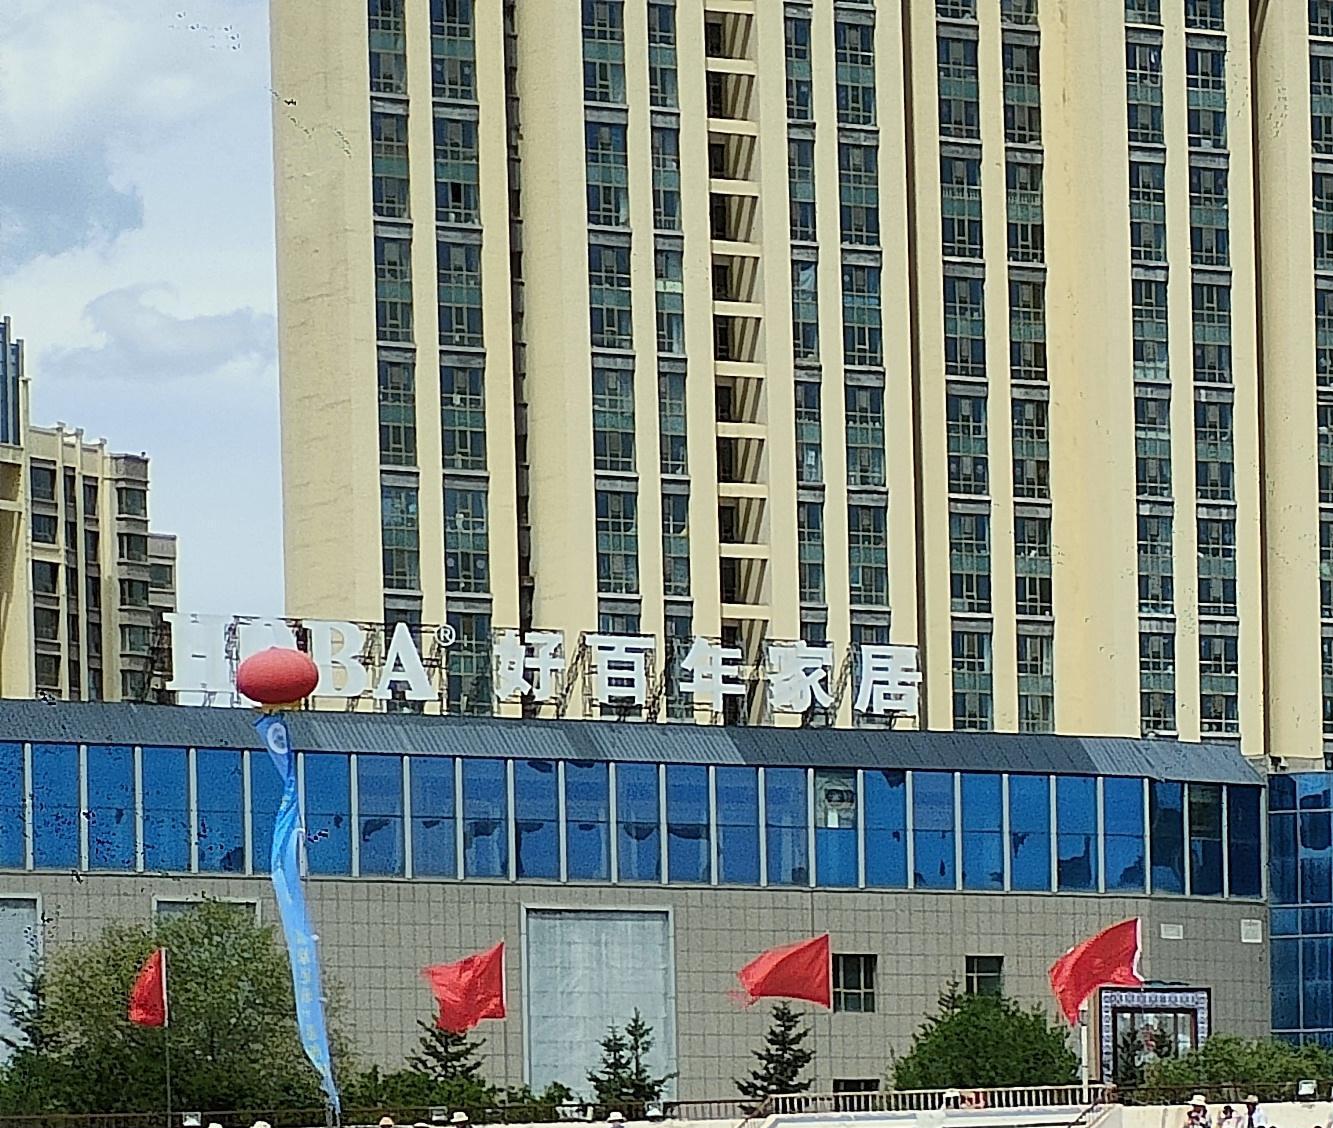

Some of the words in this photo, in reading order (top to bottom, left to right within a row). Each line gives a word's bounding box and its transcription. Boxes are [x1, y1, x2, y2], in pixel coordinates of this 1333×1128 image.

[494, 630, 923, 716] 好百年家居
